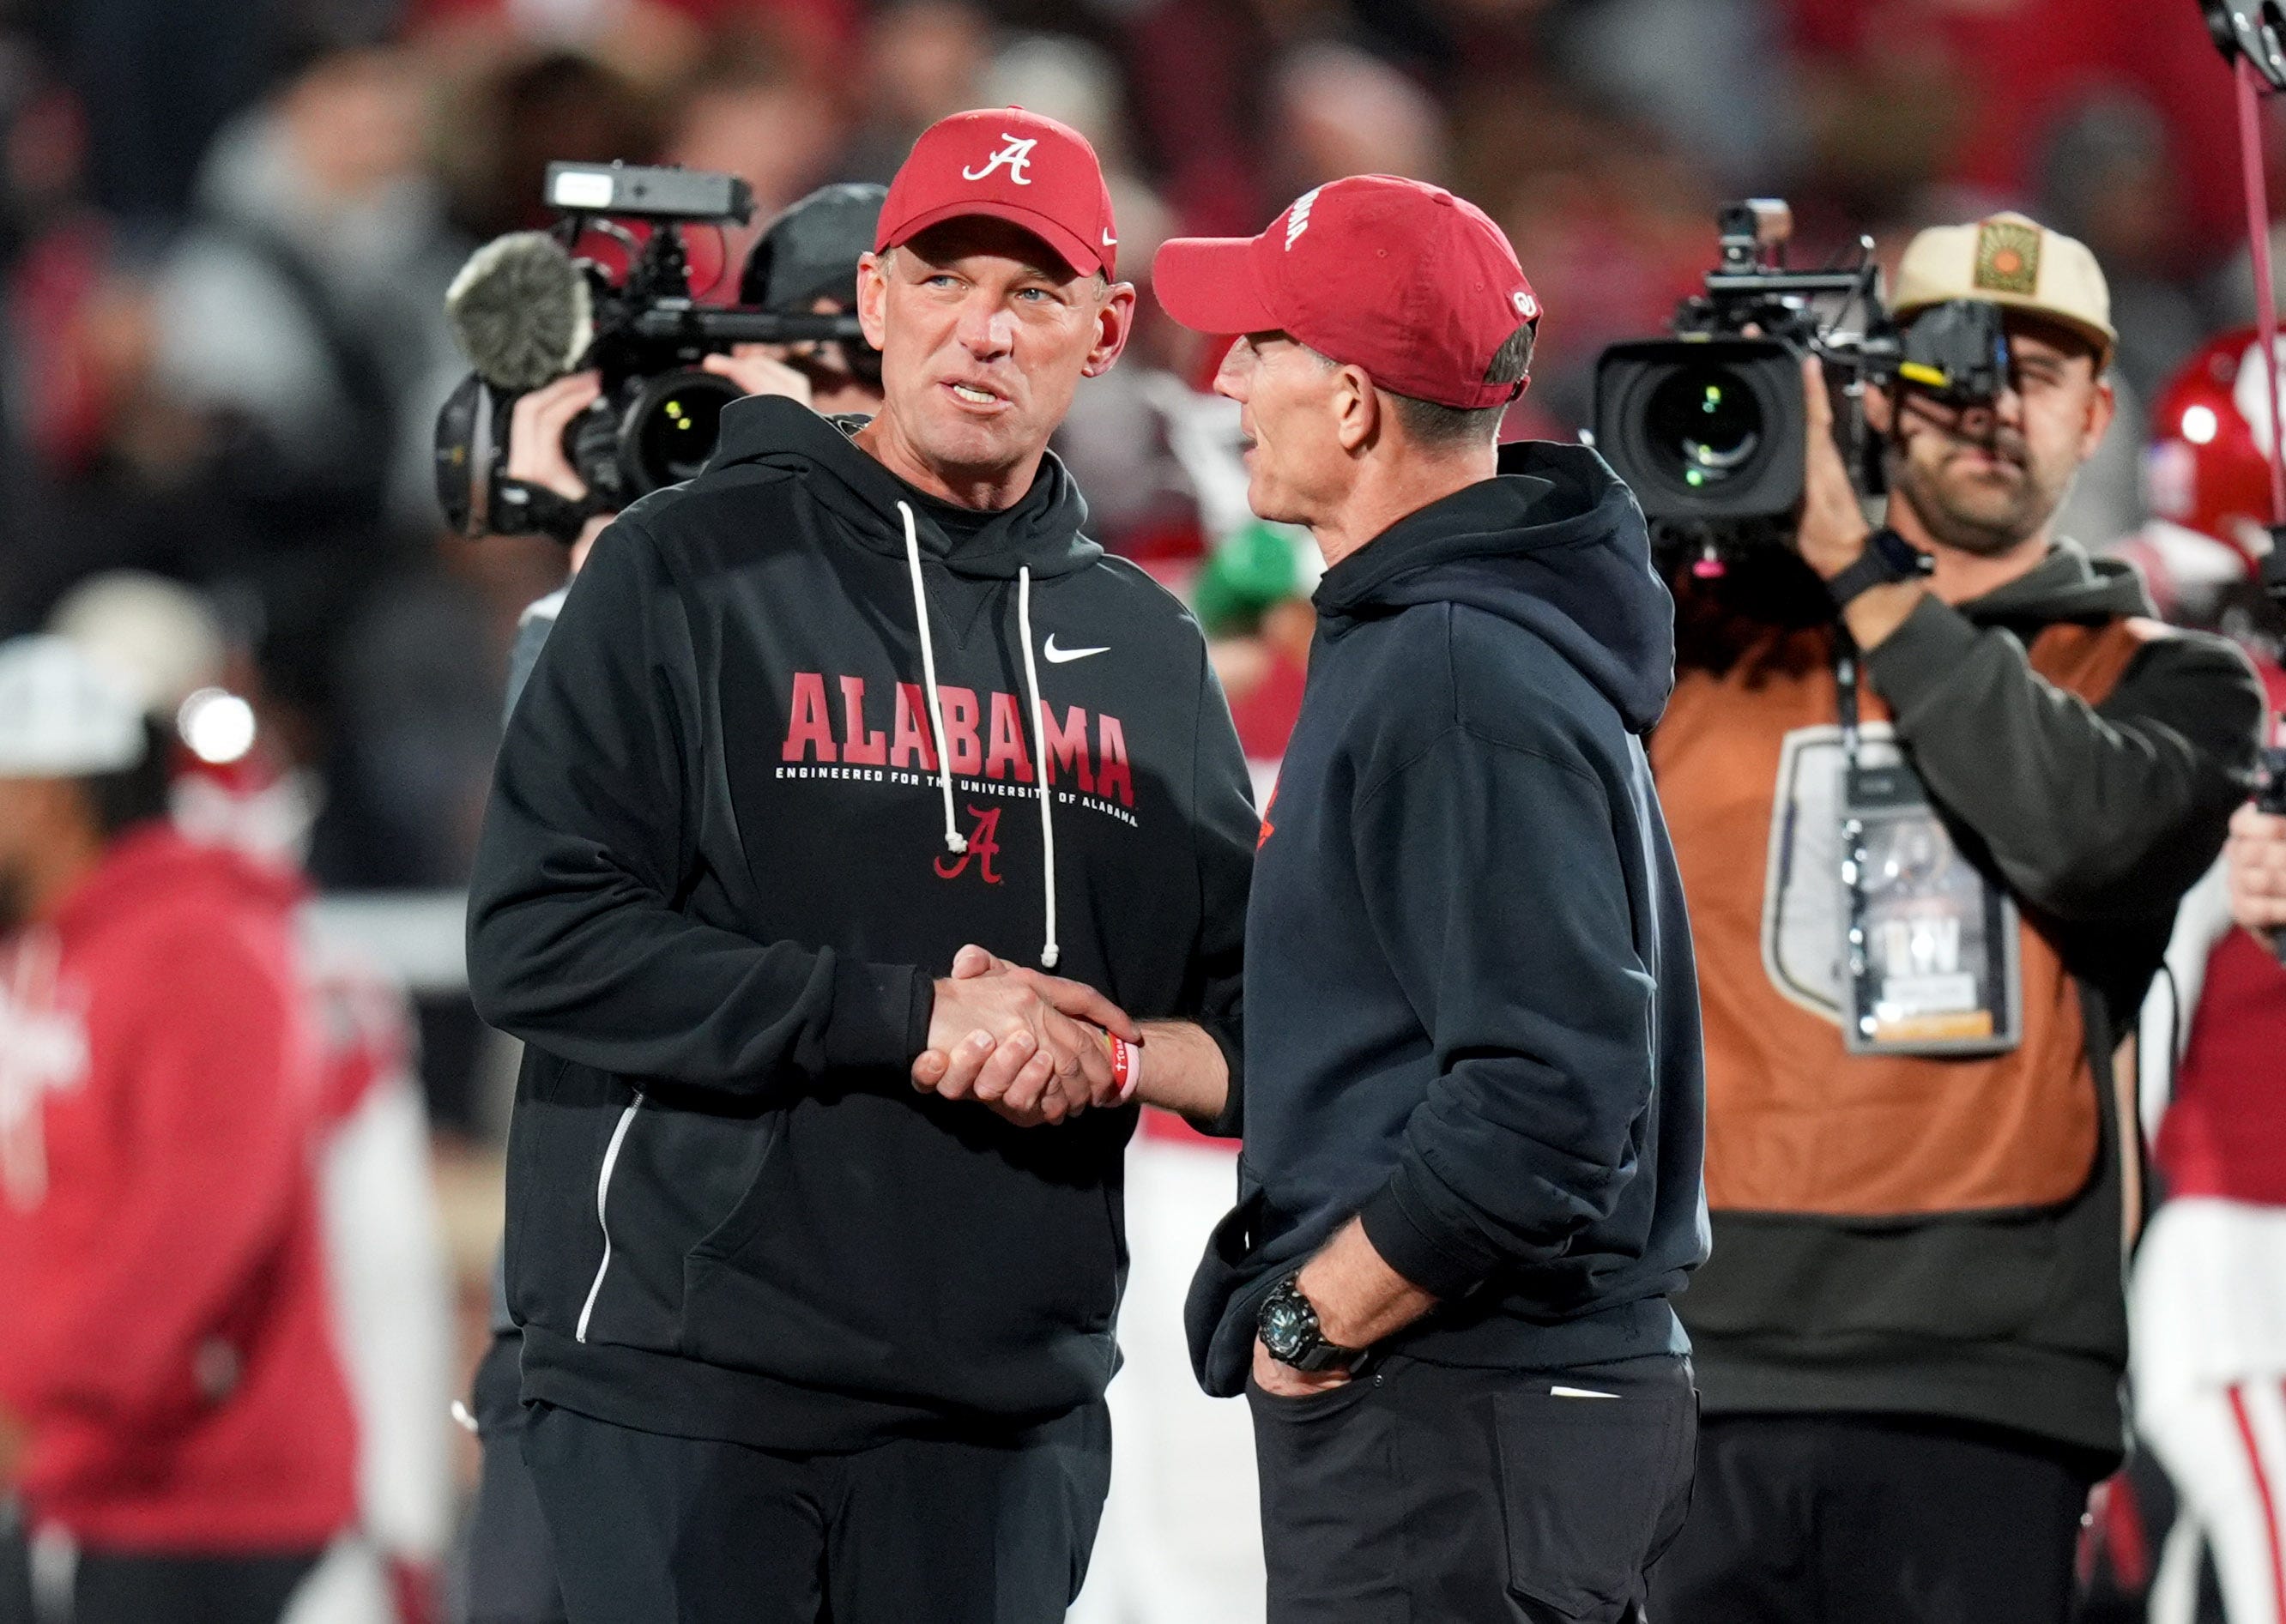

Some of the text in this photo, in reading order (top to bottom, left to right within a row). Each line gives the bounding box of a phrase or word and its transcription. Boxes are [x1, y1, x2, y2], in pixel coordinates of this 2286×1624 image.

[962, 132, 1037, 185] A
[1513, 292, 1537, 317] OU
[782, 672, 1134, 807] ALABAMA
[776, 767, 883, 782] ENGINEERED
[891, 772, 919, 785] FOR
[927, 776, 952, 788] TH
[961, 780, 1051, 799] UNIVERSIT
[1058, 792, 1076, 804] OF
[934, 803, 1001, 884] A
